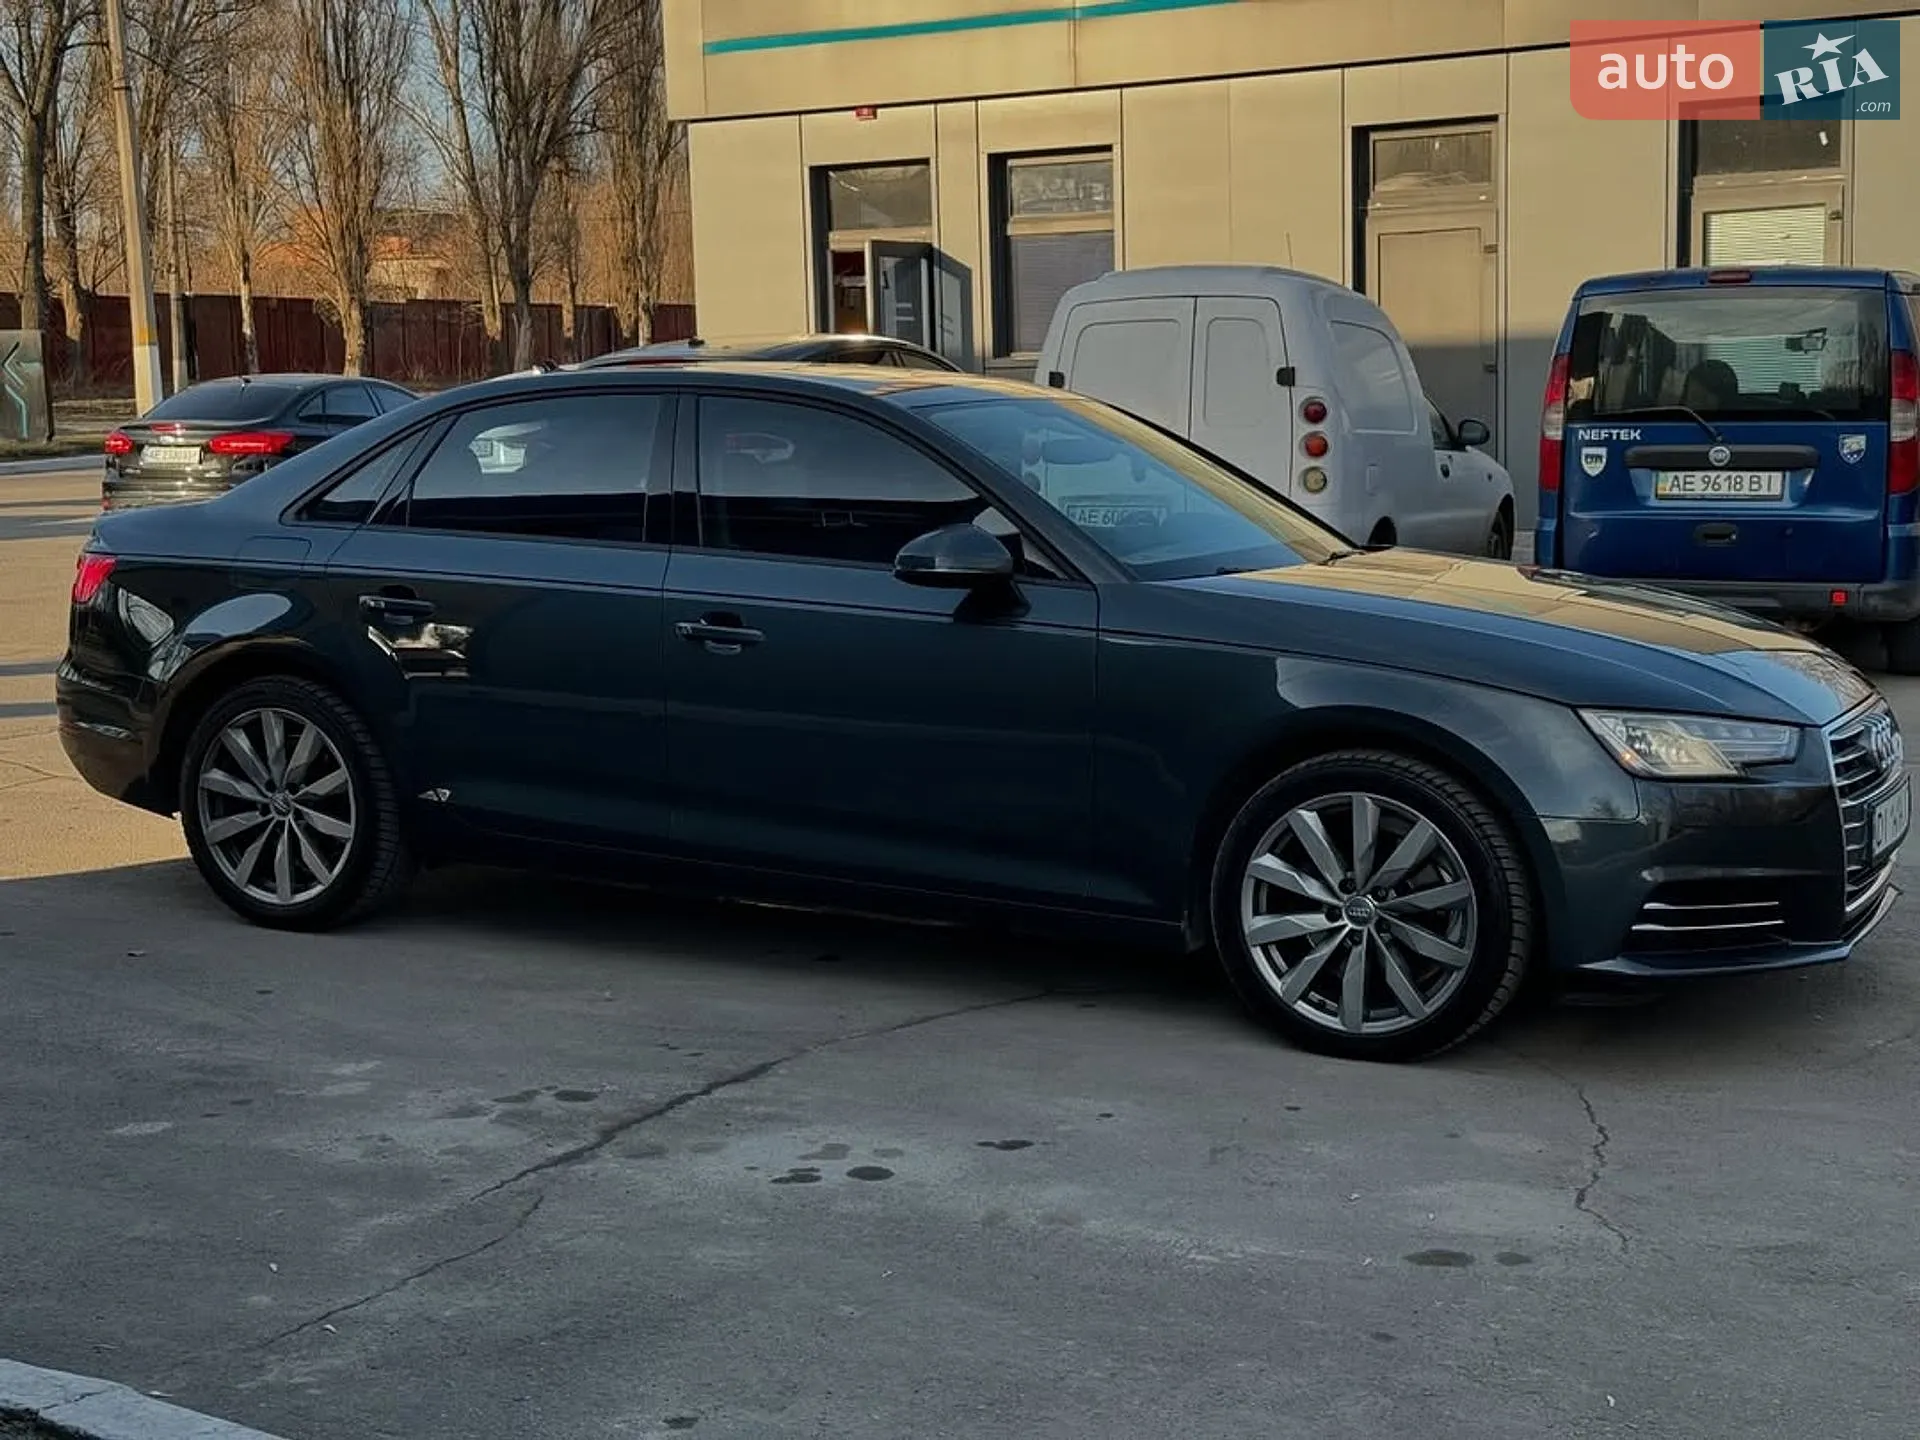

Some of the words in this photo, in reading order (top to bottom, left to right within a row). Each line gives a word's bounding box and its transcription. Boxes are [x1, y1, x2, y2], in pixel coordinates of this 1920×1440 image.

[1578, 428, 1641, 441] NEFTEK
[1669, 474, 1696, 492] AE
[1701, 474, 1744, 492] 9618
[1749, 474, 1773, 492] BI
